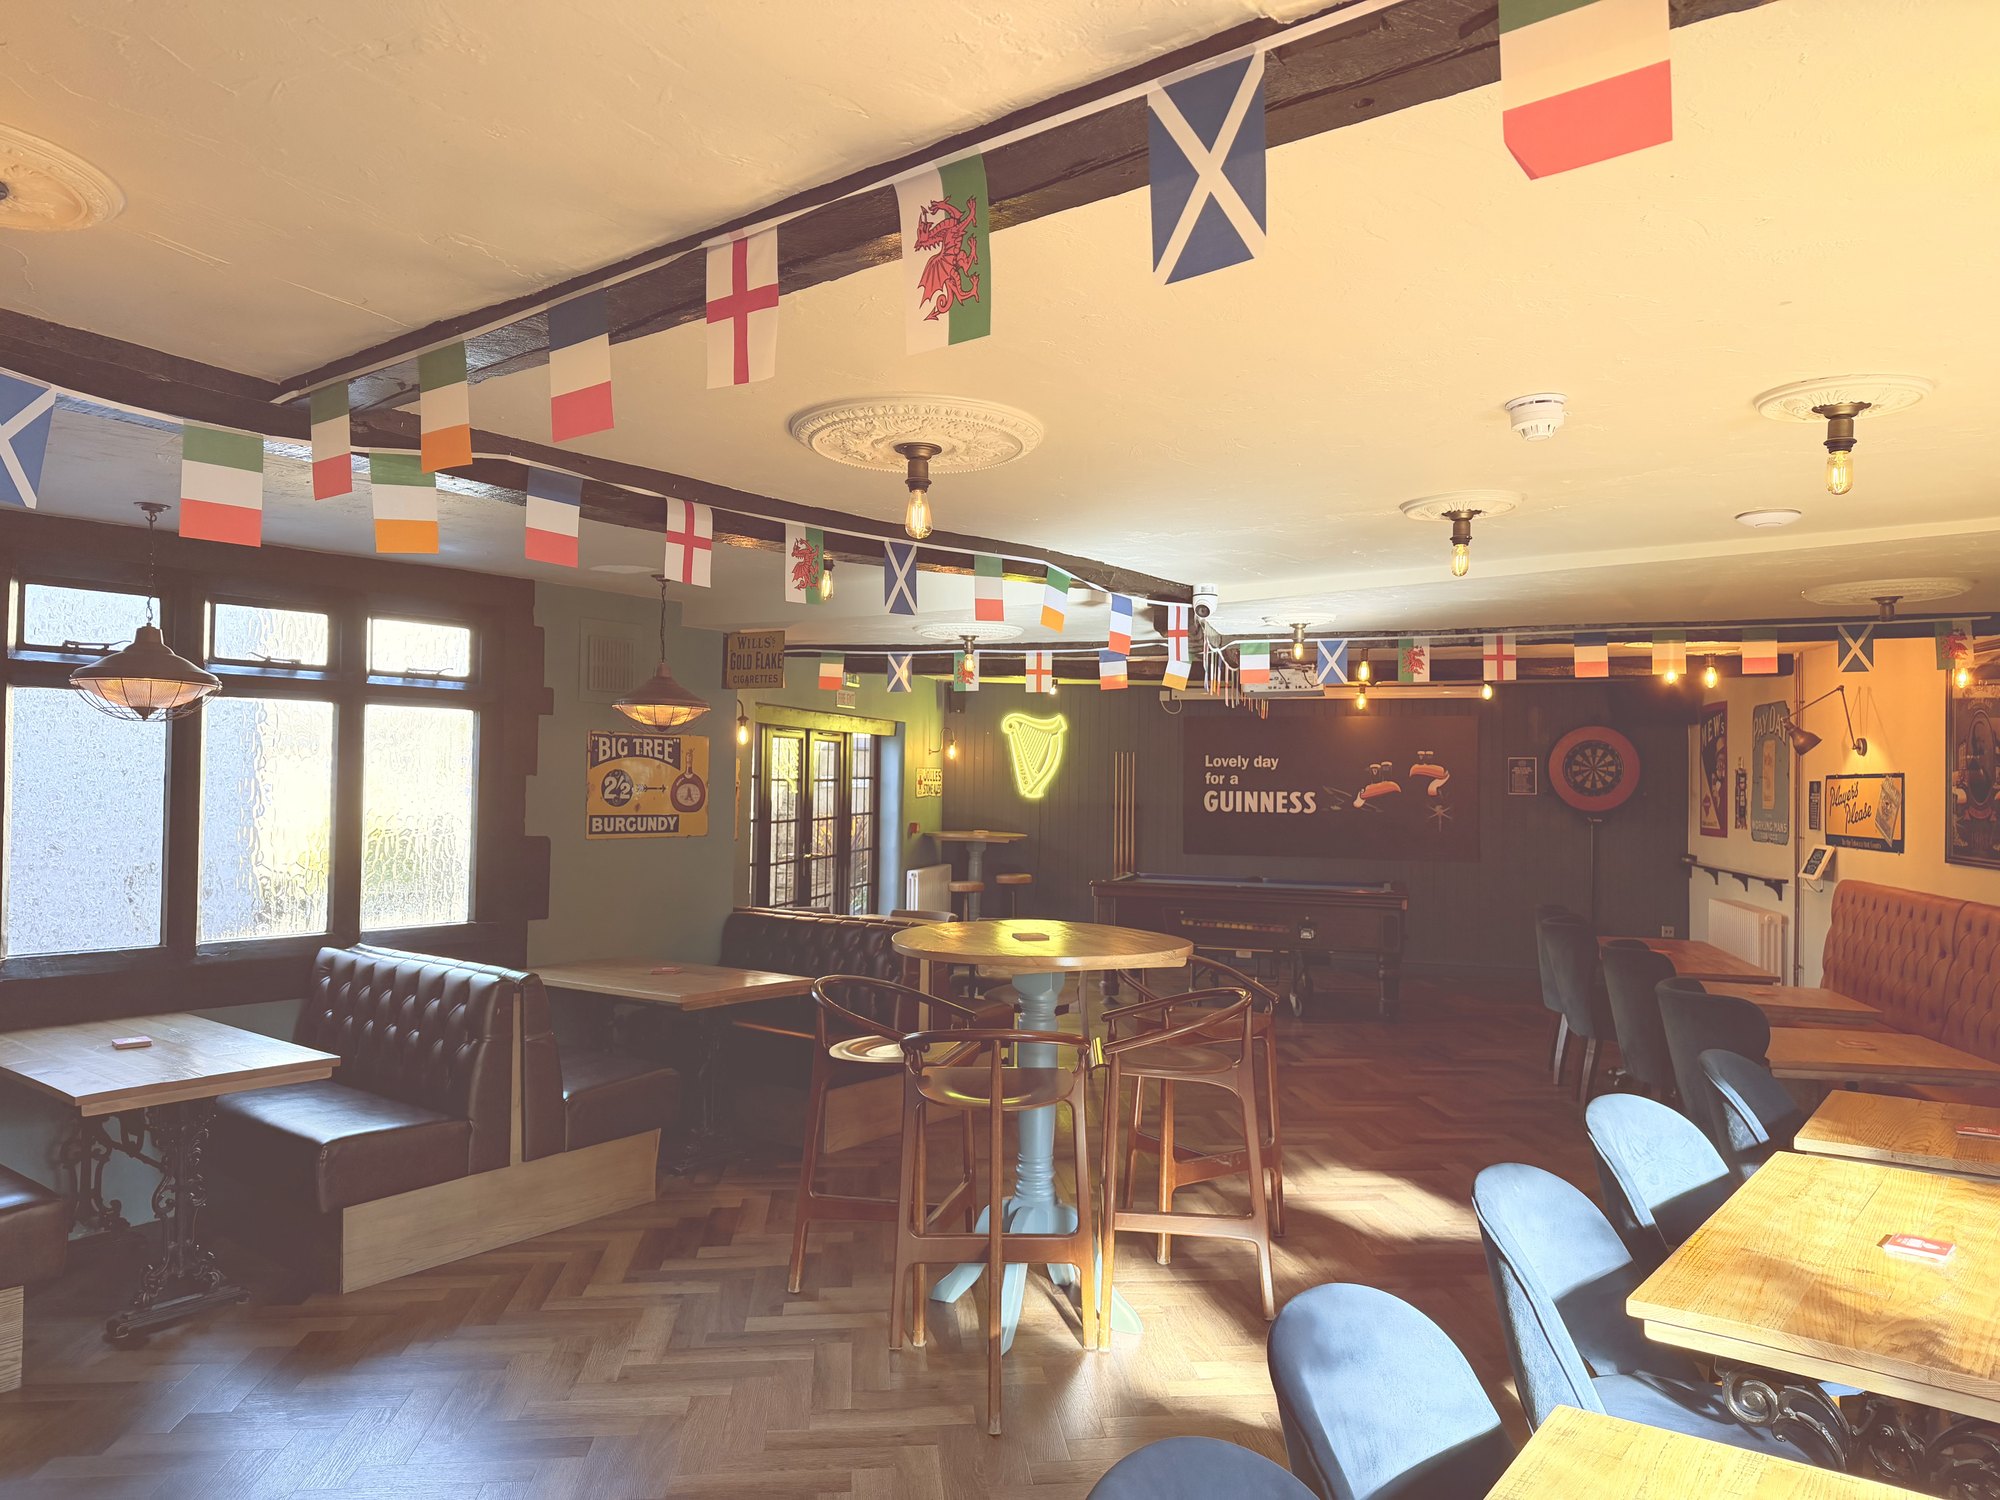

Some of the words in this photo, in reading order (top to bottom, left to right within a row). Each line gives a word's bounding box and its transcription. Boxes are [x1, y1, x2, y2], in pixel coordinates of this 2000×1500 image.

[730, 652, 752, 670] GOLD
[755, 651, 783, 670] FLAKE
[732, 674, 778, 684] CIGARETTES
[1752, 712, 1769, 748] PAY
[1204, 754, 1249, 770] Lovely
[1253, 754, 1279, 770] day
[1204, 772, 1225, 785] for
[1229, 775, 1239, 785] a
[1203, 789, 1317, 814] GUINNESS
[591, 816, 678, 832] BURGUNDY
[1844, 801, 1872, 834] Please
